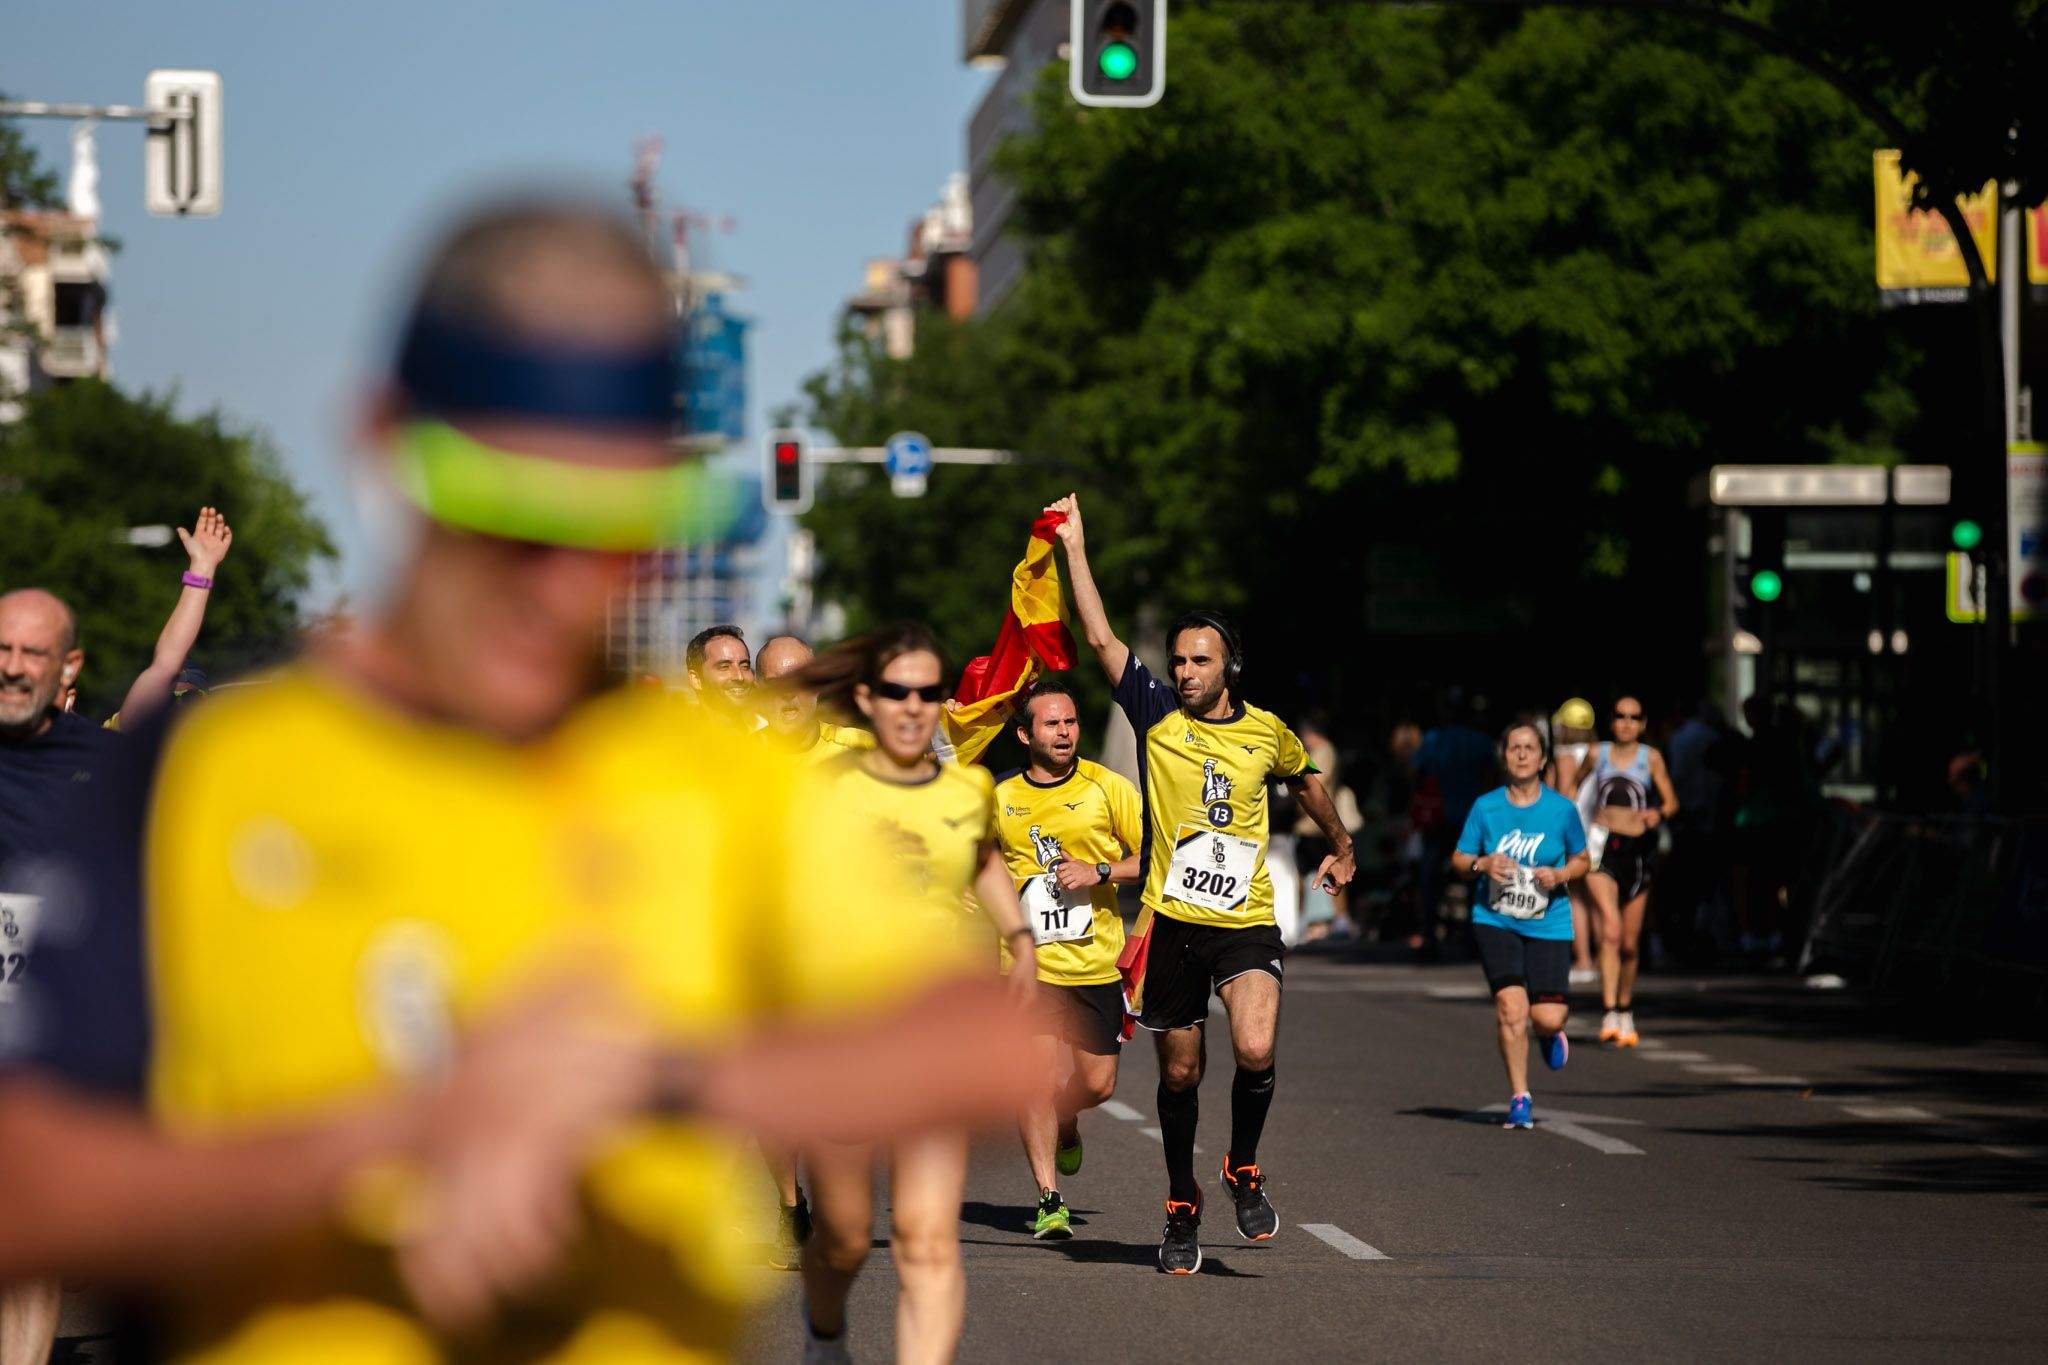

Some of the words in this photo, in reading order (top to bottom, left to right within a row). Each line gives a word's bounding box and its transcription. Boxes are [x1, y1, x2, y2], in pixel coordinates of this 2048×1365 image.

[1213, 807, 1229, 822] 13
[1496, 828, 1545, 866] Run
[1183, 867, 1236, 898] 3202
[1040, 907, 1069, 931] 717
